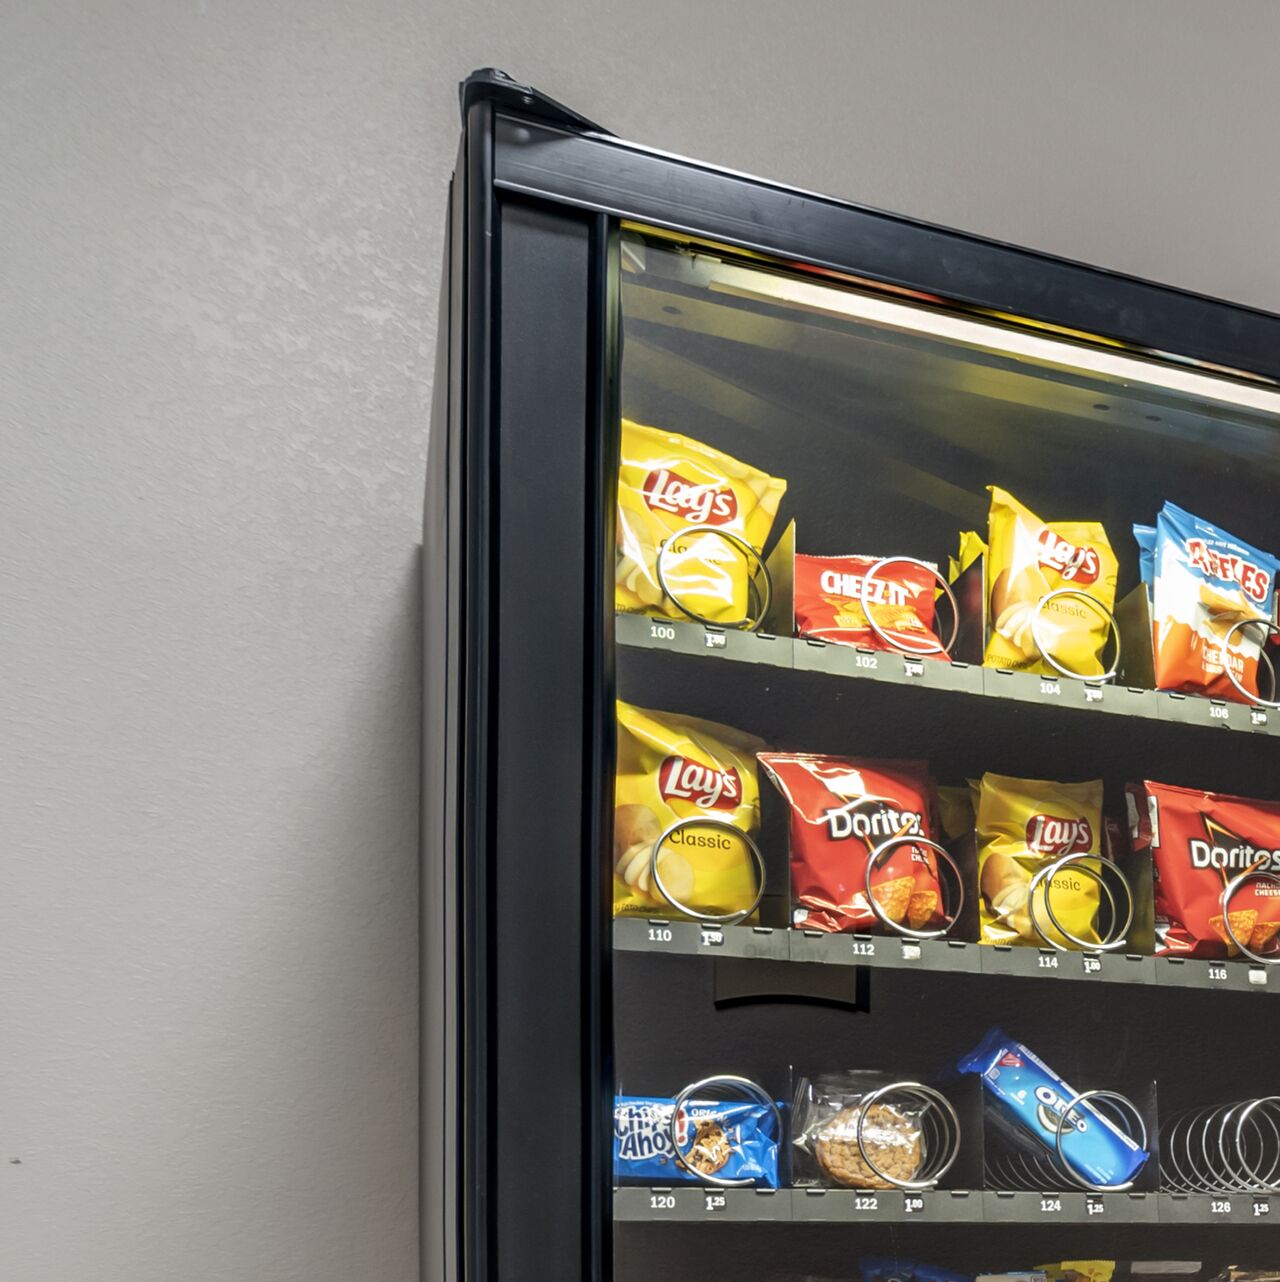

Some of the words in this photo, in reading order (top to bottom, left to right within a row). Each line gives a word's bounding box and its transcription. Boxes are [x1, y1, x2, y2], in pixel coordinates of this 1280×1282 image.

[1039, 532, 1098, 581] Lay's
[650, 626, 675, 639] 100
[856, 656, 877, 669] 102
[1202, 644, 1245, 673] CHEDAR
[1040, 683, 1061, 695] 104
[1209, 707, 1229, 719] 106
[664, 757, 737, 808] Lay's
[669, 830, 731, 850] Classic
[1030, 815, 1089, 855] Lay's
[648, 929, 672, 941] 110
[853, 944, 875, 955] 112
[1038, 956, 1058, 968] 114
[1208, 968, 1228, 980] 116
[1035, 1086, 1088, 1133] OREO
[650, 1197, 675, 1208] 120
[855, 1198, 878, 1211] 122
[1040, 1200, 1061, 1212] 124
[1211, 1201, 1231, 1214] 126
